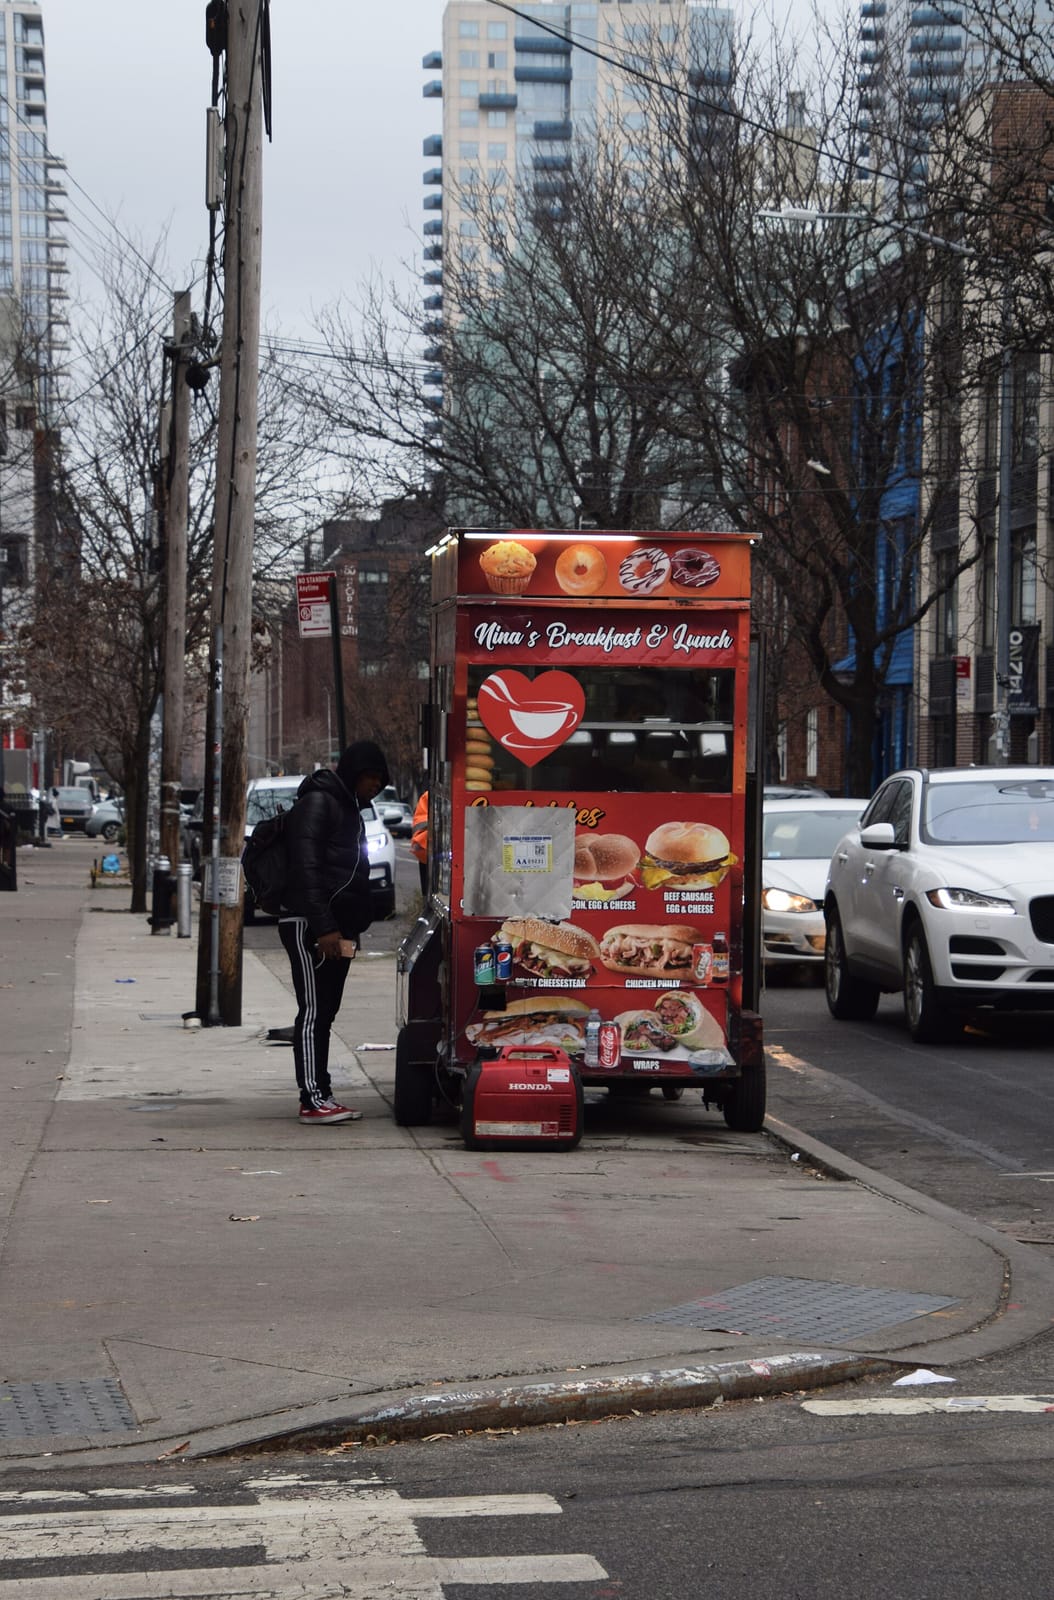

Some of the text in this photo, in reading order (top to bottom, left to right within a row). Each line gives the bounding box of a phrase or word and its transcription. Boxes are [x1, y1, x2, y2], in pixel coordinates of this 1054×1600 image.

[299, 584, 319, 592] Anytime
[473, 620, 733, 654] Nina's Breakfast & Lunch
[664, 892, 681, 901] BEEF
[571, 900, 636, 910] CON, EGG & CHEESE
[666, 904, 714, 914] EGG & CHEESE
[538, 978, 586, 987] CHEESESTEAK
[625, 979, 681, 988] CHICKEN PHILLY
[633, 1060, 660, 1070] WRAPS
[508, 1083, 553, 1091] HONDA
